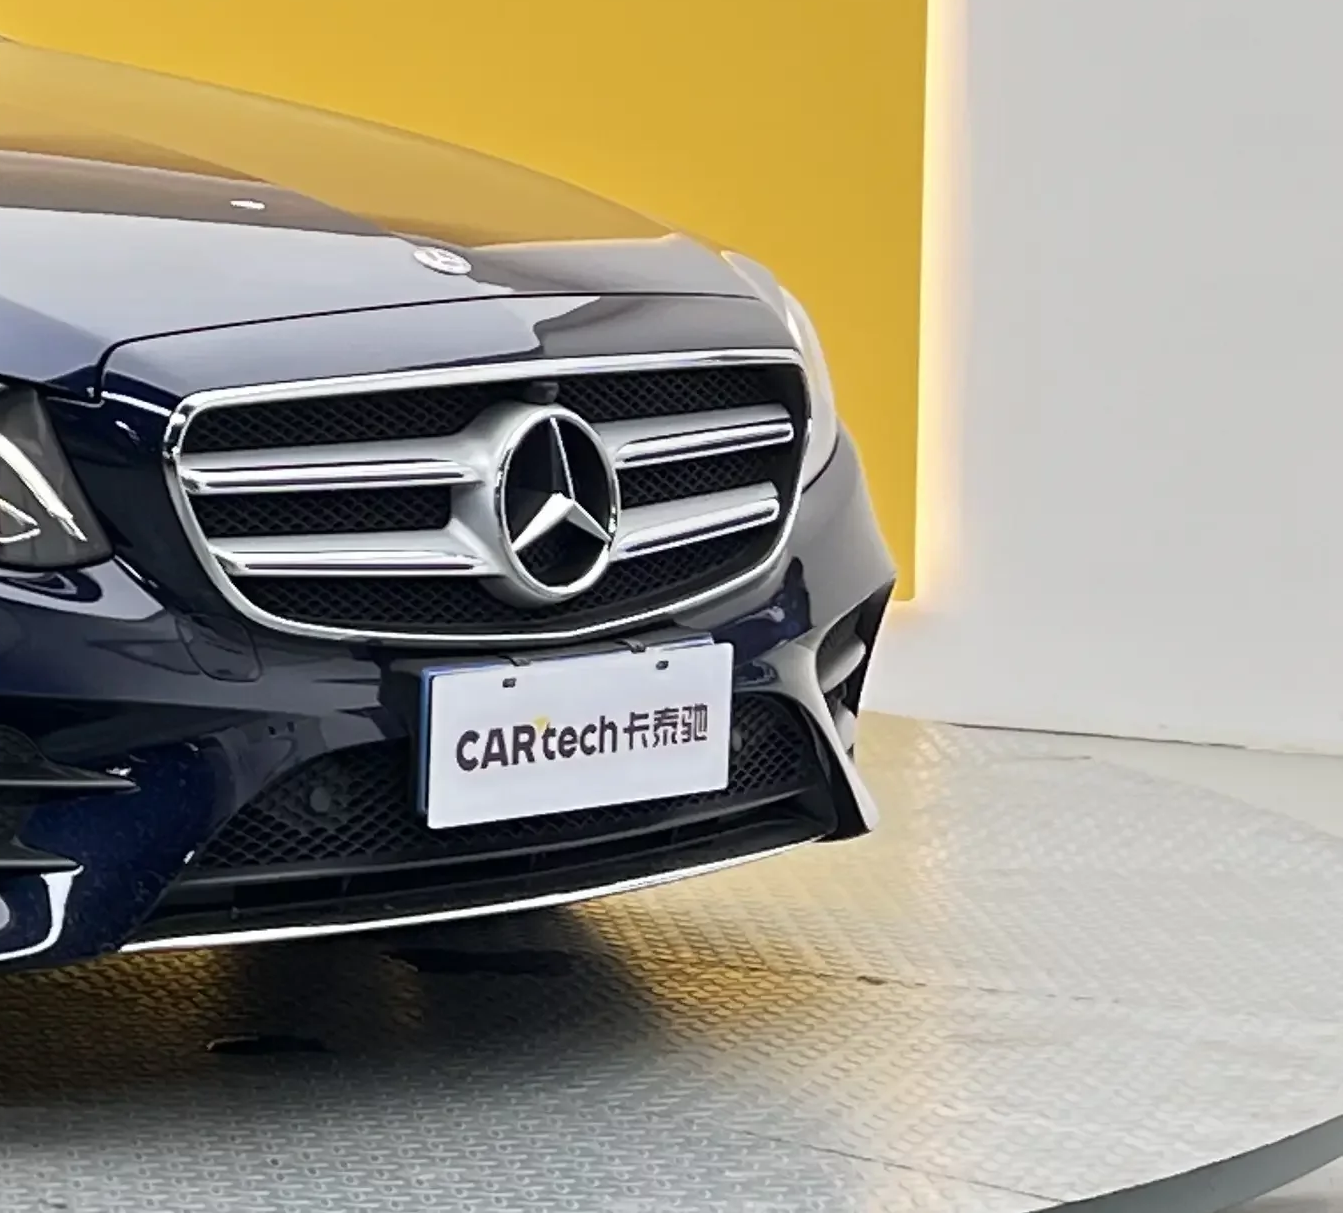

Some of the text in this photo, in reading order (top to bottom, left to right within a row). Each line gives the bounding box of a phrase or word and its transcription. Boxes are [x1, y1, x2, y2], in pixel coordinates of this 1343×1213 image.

[456, 702, 709, 772] CARtech 卡泰驰
